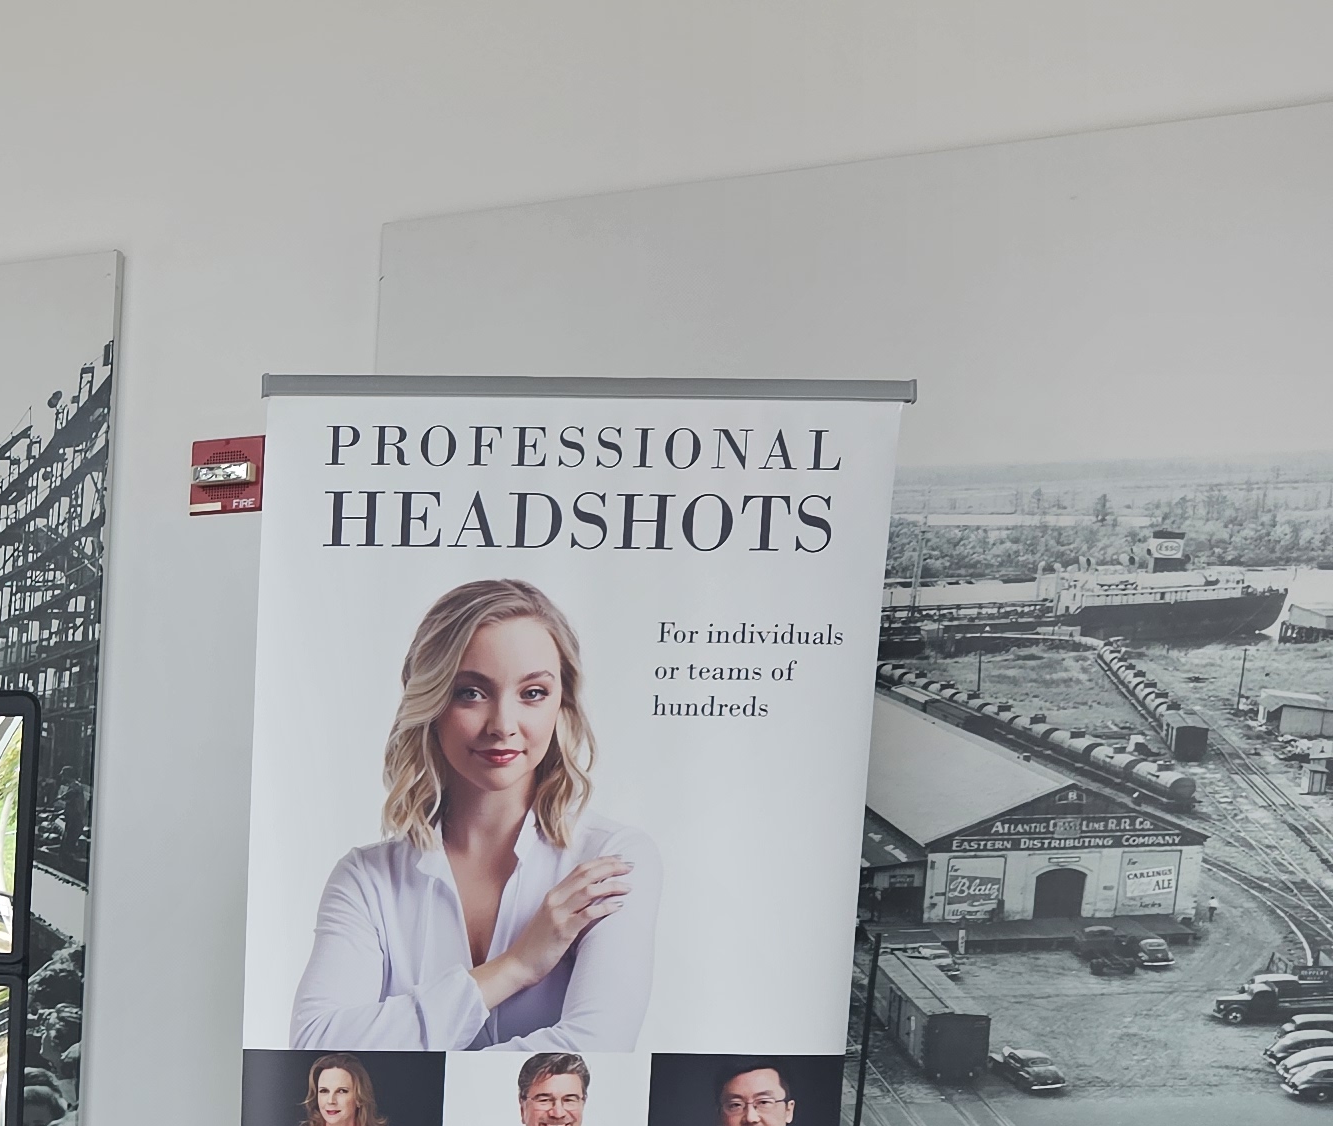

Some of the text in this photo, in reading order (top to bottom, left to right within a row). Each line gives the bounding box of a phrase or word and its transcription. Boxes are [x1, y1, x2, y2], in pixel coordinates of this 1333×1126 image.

[324, 424, 842, 472] PROFESSIONAL
[232, 498, 256, 509] FIRE
[322, 490, 832, 553] HEADSHOTS
[657, 621, 844, 646] For individuals
[654, 659, 798, 681] or teams of
[652, 694, 769, 718] hundreds
[991, 821, 1047, 833] ATLANTIC
[1082, 820, 1105, 831] LINE
[952, 835, 1182, 850] EASTERN DISTRIBUTING COMPANY
[1152, 878, 1173, 891] ALE
